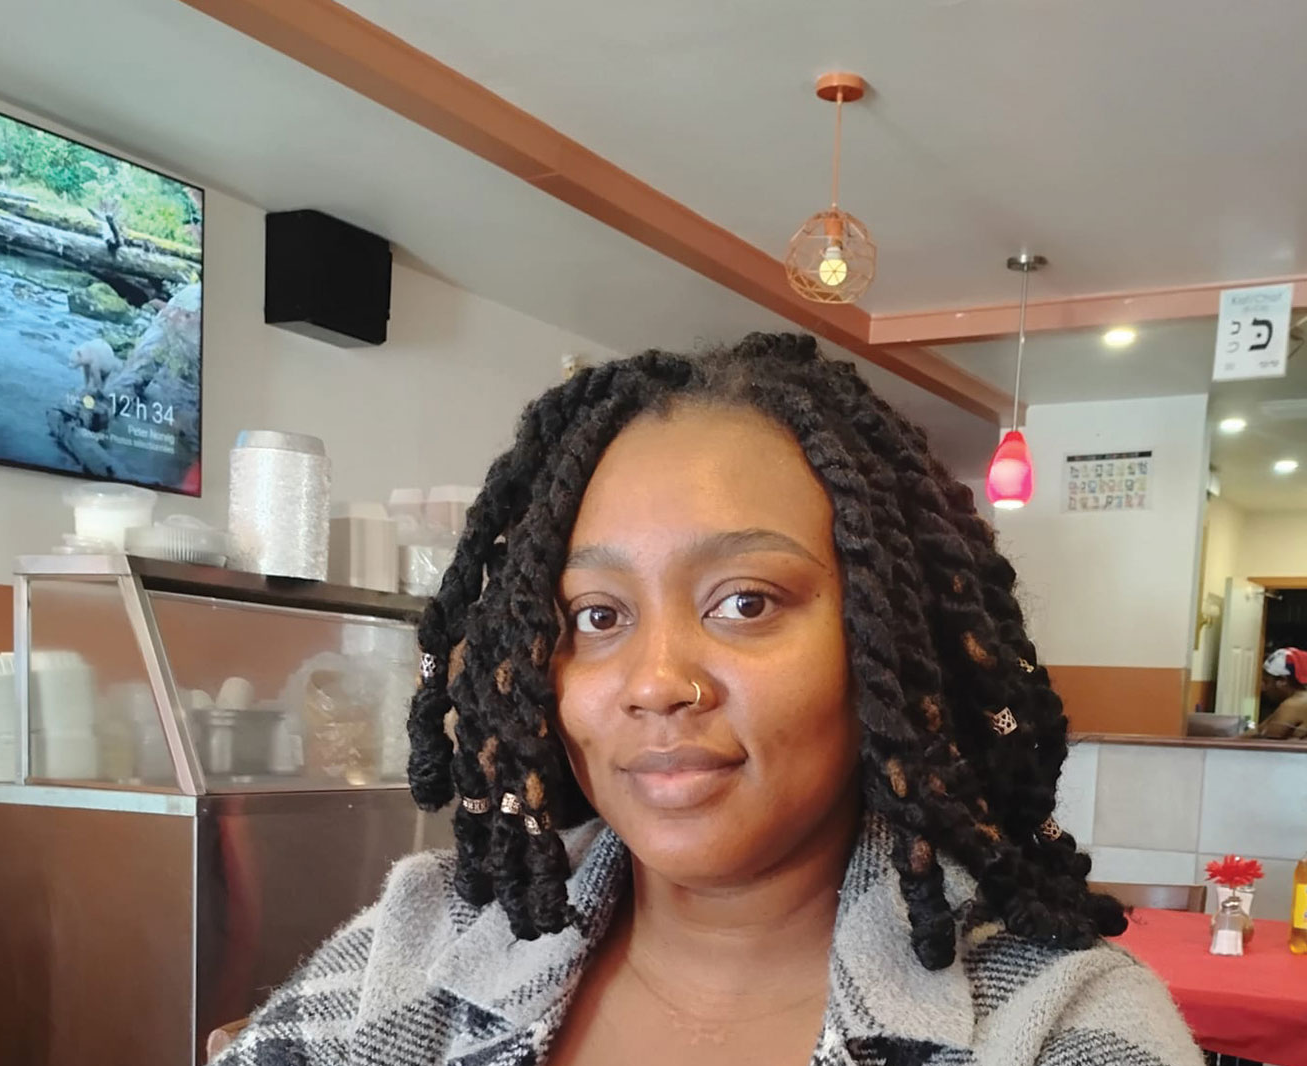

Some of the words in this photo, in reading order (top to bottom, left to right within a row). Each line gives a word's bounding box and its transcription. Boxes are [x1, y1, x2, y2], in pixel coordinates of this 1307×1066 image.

[108, 392, 132, 418] 12
[136, 397, 148, 420] h
[151, 402, 176, 426] 34
